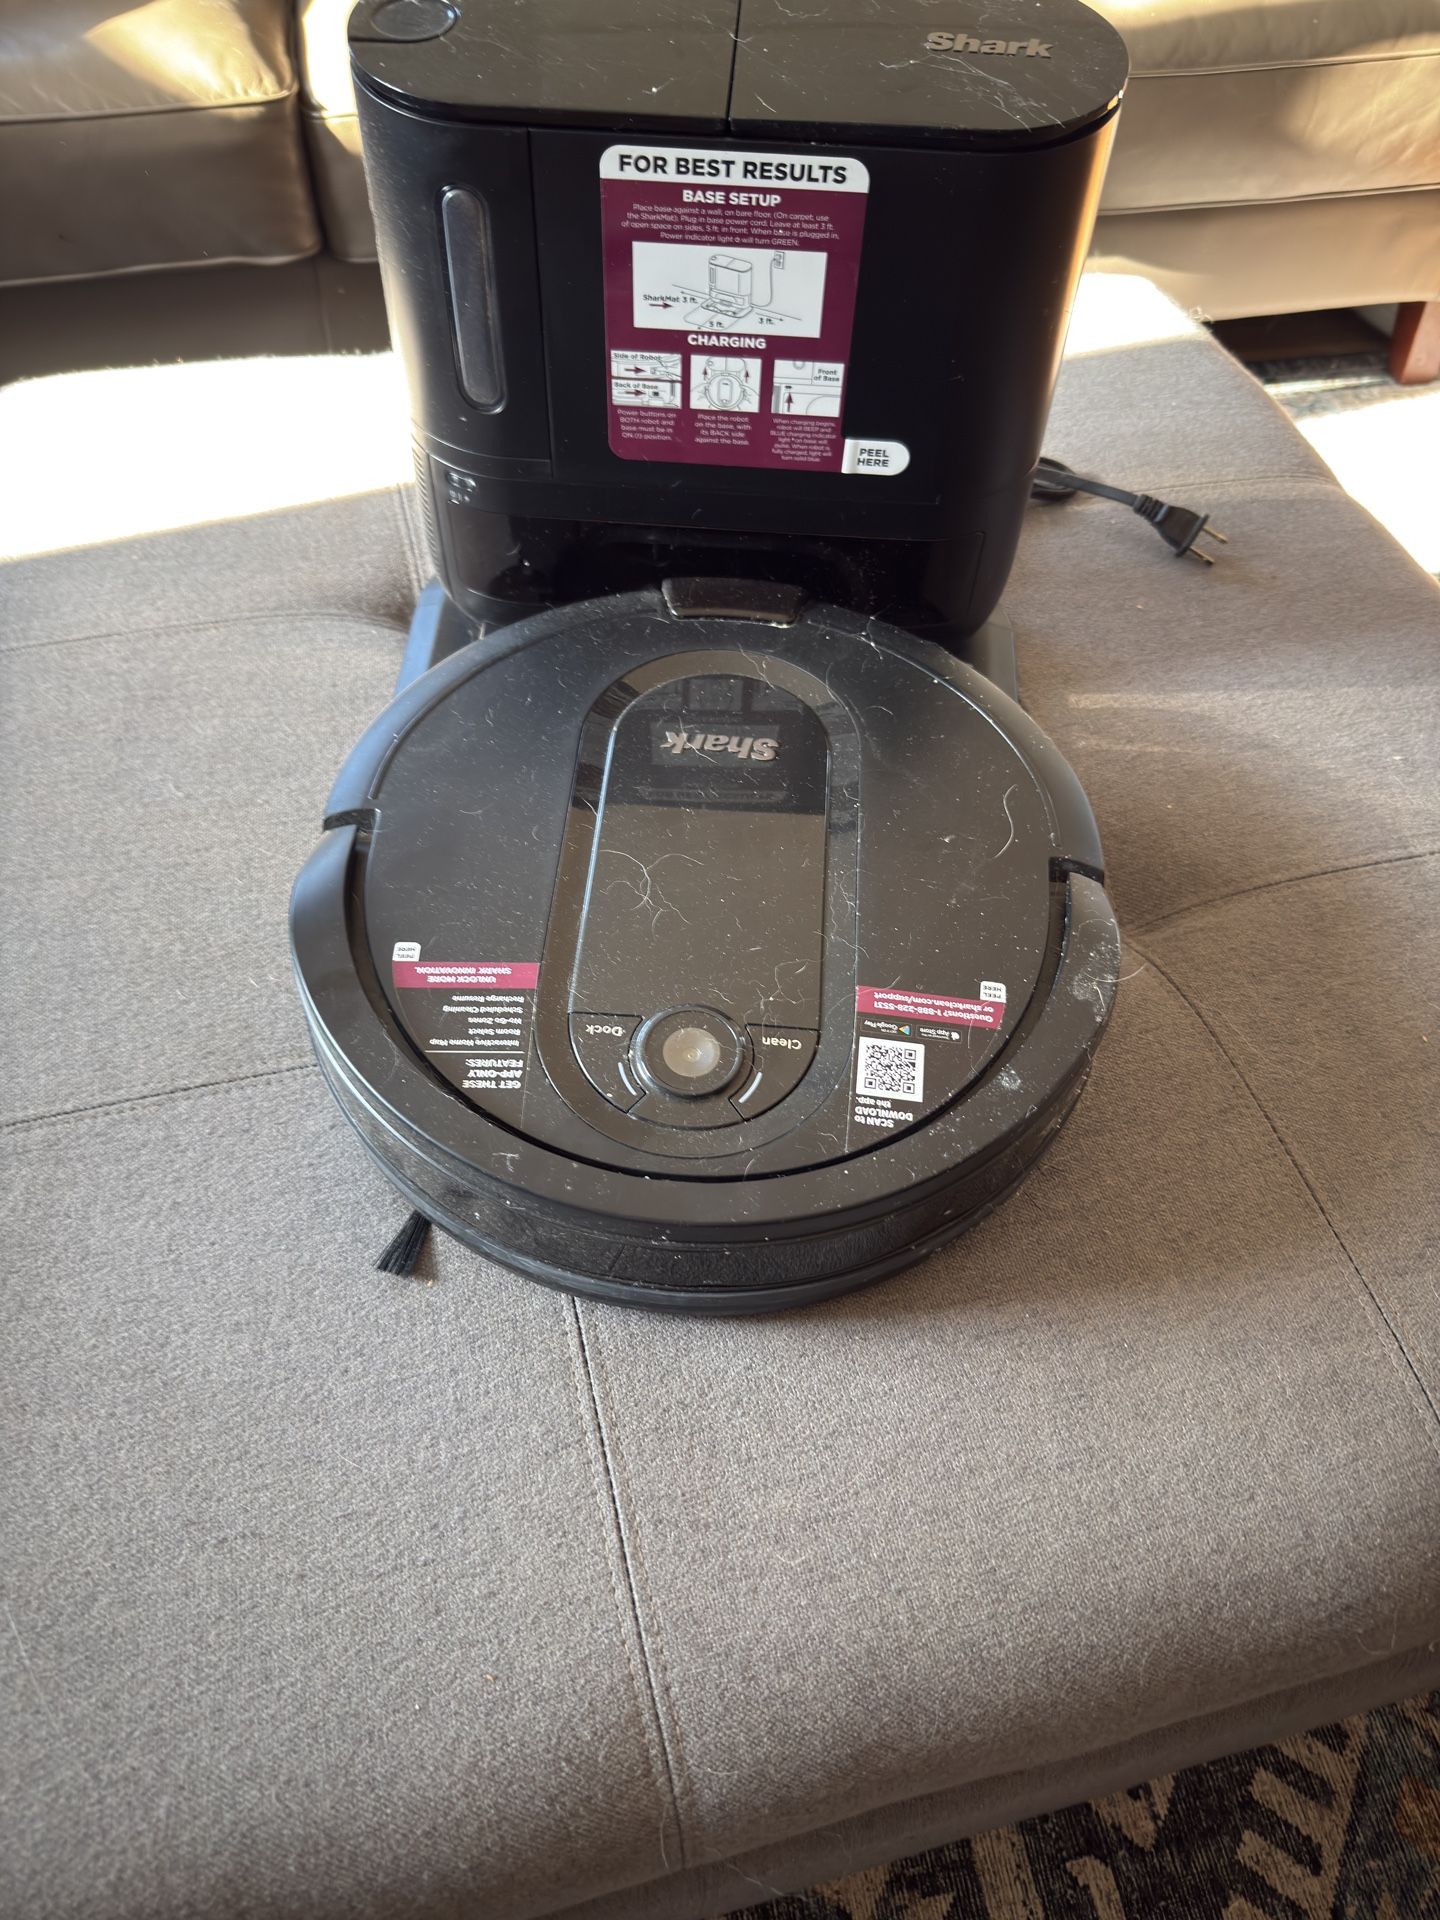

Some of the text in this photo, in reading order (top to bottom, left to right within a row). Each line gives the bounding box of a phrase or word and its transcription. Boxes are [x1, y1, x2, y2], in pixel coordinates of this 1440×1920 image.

[925, 31, 1053, 58] Shark
[618, 154, 847, 184] FOR BEST RESULTS
[682, 189, 781, 207] BASE SETUP
[632, 204, 653, 212] Place
[654, 205, 672, 213] base
[673, 207, 699, 215] against
[626, 212, 640, 220] the
[680, 215, 698, 224] Plug
[707, 217, 725, 225] base
[770, 220, 792, 228] Leave
[802, 222, 820, 230] least
[660, 232, 683, 240] Power
[685, 233, 716, 242] indicator
[772, 238, 801, 247] GREEN.
[774, 229, 793, 237] base
[800, 231, 831, 240] plugged
[642, 294, 681, 303] SharkMat
[682, 296, 700, 305] 3 ft.
[759, 317, 766, 325] 3
[687, 334, 767, 350] CHARGING
[614, 352, 629, 360] Side
[640, 354, 661, 362] Robot
[818, 368, 838, 376] Front
[859, 448, 889, 458] PEEL
[857, 458, 889, 468] HERE
[660, 731, 779, 761] Shark
[414, 966, 512, 975] SHARK INNOVATION.
[457, 976, 497, 984] UNLOCK
[452, 994, 525, 1003] Recharge Resume
[874, 992, 980, 1011] sharkclean.com/support
[442, 1005, 523, 1014] Scheduled Cleaning
[943, 1008, 993, 1023] Questions?
[864, 1020, 899, 1030] Google Play
[468, 1028, 521, 1036] Room Select
[586, 1024, 624, 1037] Dock
[920, 1027, 935, 1035] Store
[429, 1038, 448, 1046] Map
[448, 1039, 474, 1047] Home
[762, 1036, 802, 1051] Clean
[465, 1059, 524, 1068] FEATURES:
[468, 1070, 522, 1078] APP-ONLY
[462, 1080, 522, 1089] GET THESE
[856, 1096, 892, 1108] the app.
[854, 1106, 913, 1121] DOWNLOAD
[854, 1114, 894, 1128] SCAN to
